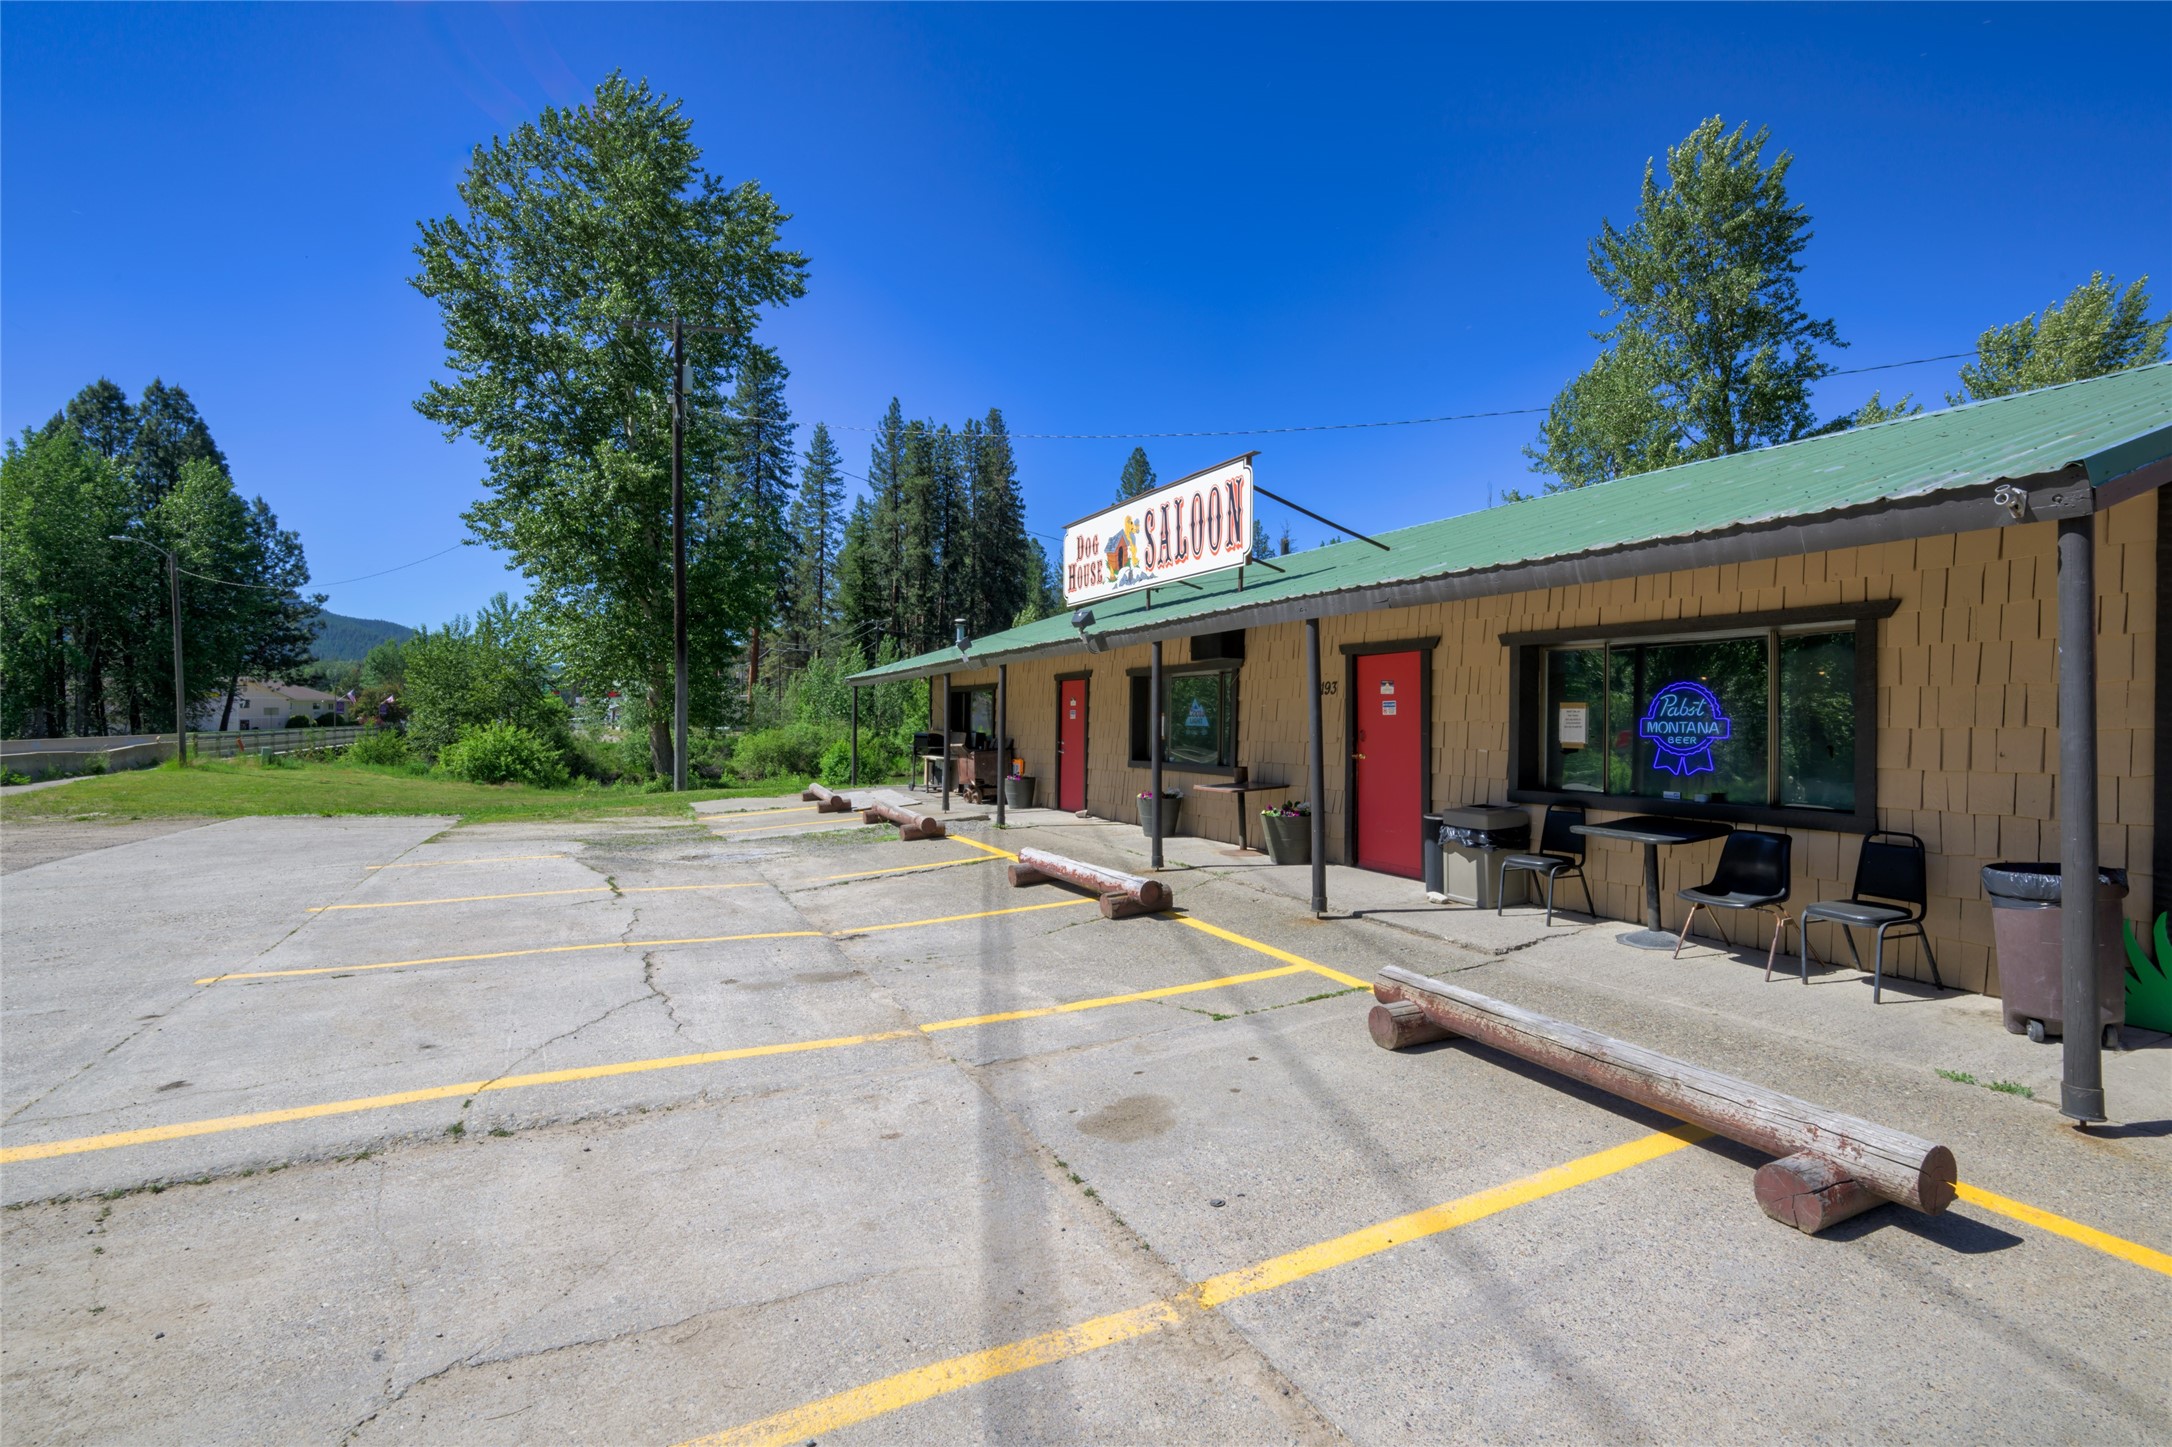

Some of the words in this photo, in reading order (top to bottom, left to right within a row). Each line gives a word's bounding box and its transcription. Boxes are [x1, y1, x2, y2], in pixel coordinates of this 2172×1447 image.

[1144, 475, 1244, 571] SALOON
[1660, 693, 1707, 717] Pabst
[1646, 721, 1720, 735] MONTANA
[1668, 736, 1697, 746] BEER
